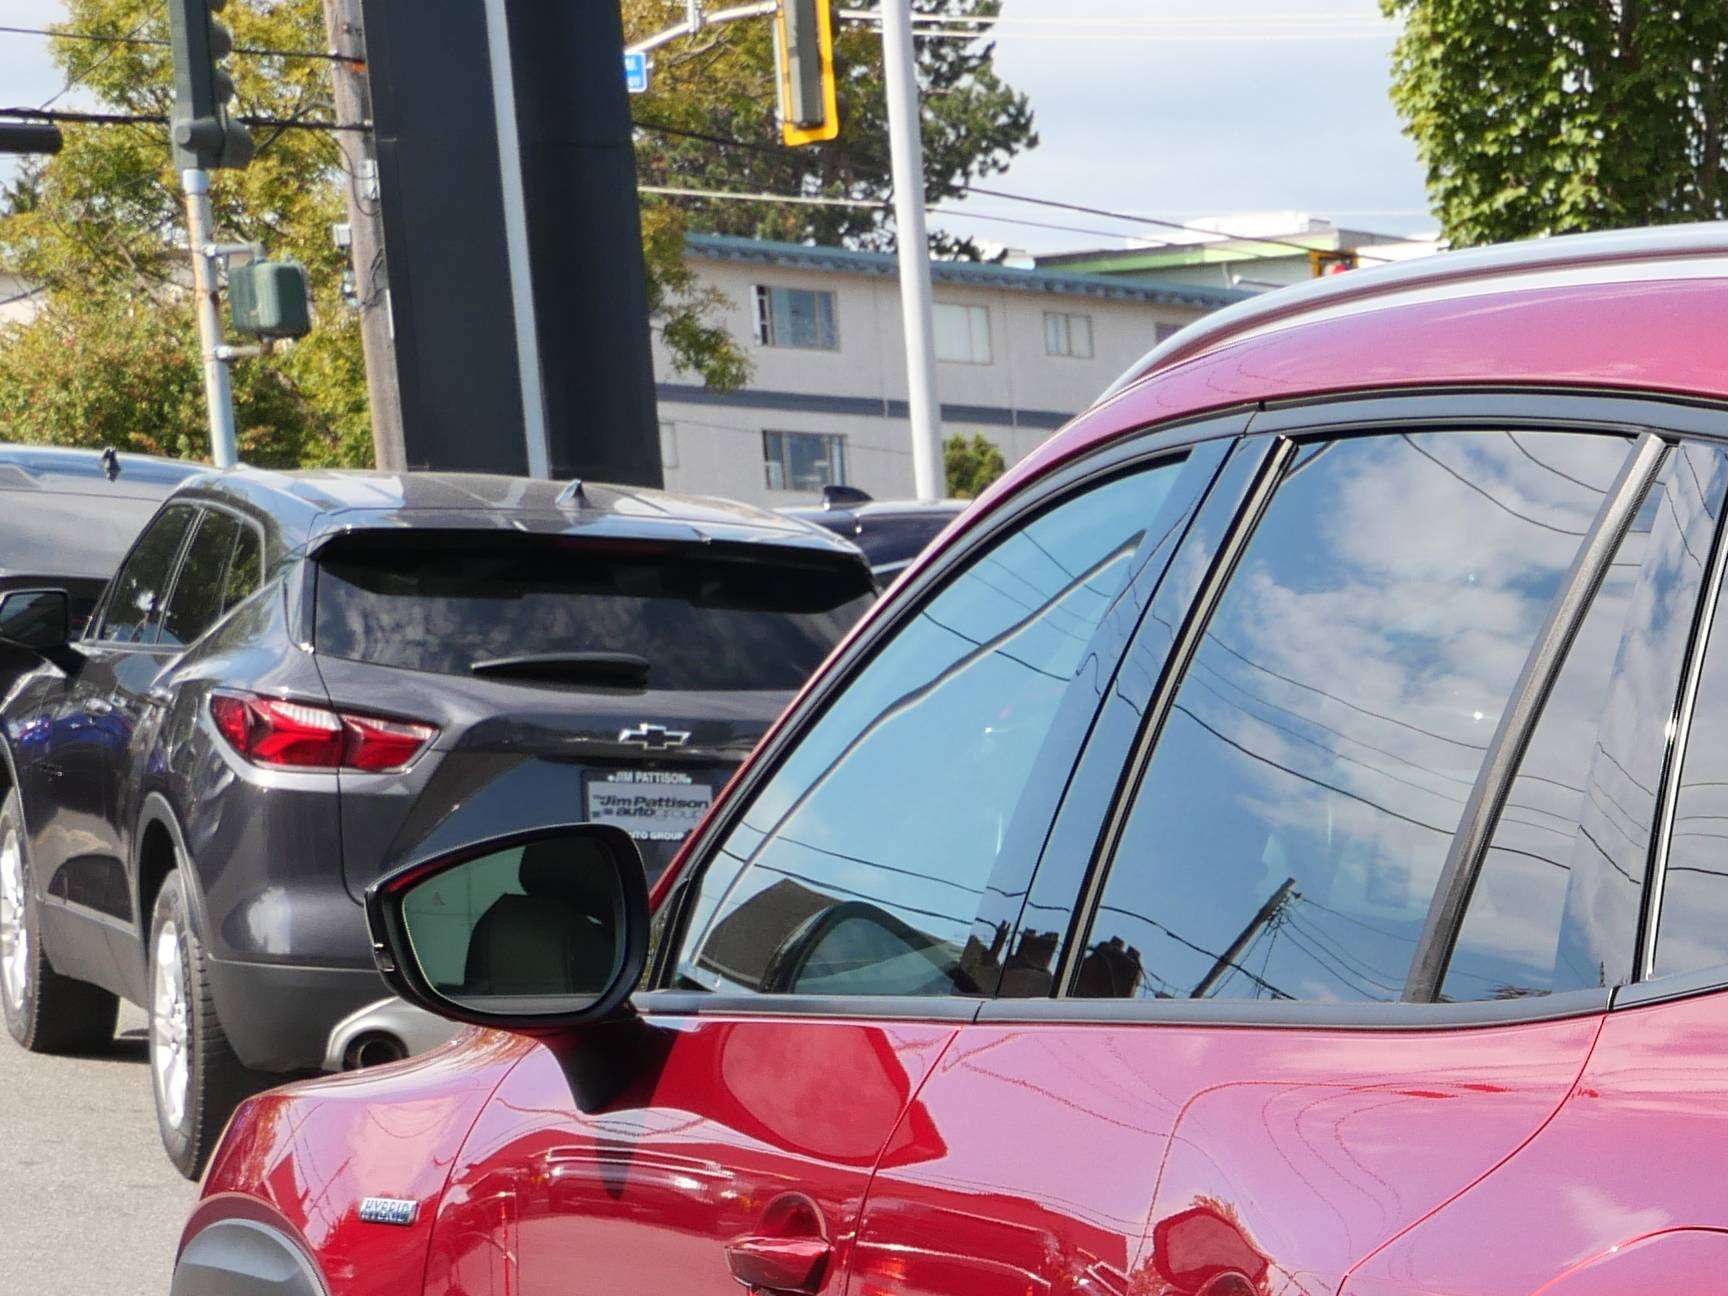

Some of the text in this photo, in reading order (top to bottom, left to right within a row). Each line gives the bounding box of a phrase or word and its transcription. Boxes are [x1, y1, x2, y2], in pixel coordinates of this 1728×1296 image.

[614, 771, 688, 784] JIM PATTISON
[634, 797, 709, 809] Pattison
[650, 831, 684, 840] GROUP
